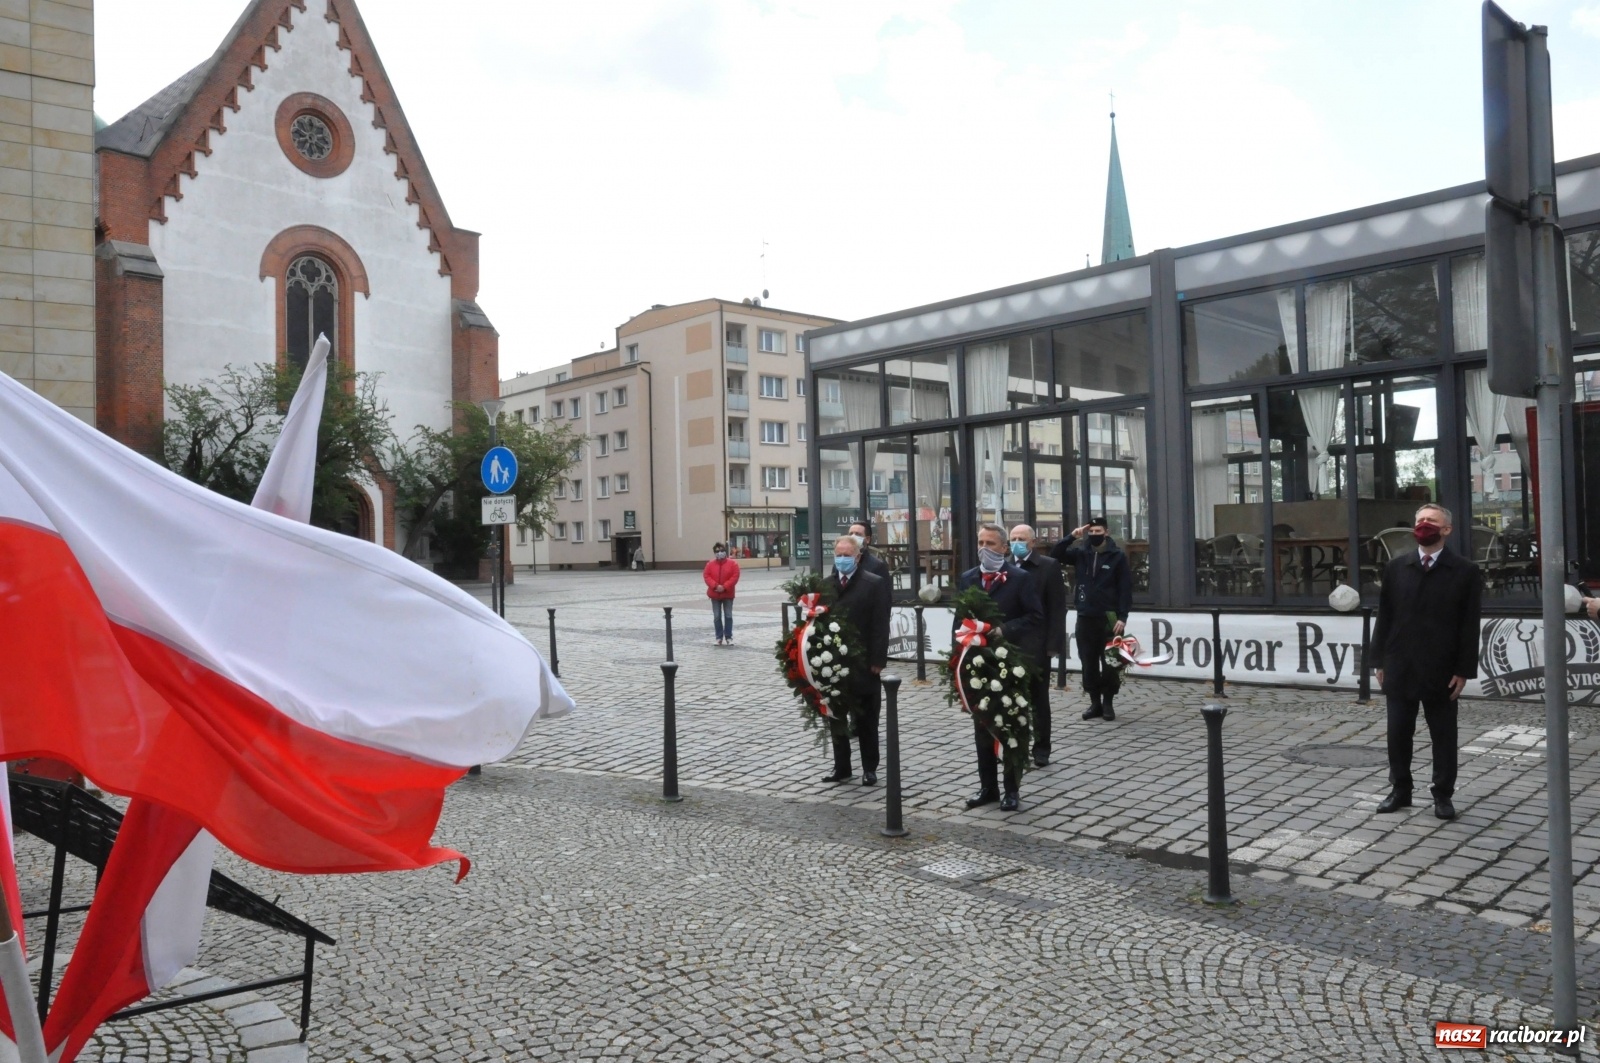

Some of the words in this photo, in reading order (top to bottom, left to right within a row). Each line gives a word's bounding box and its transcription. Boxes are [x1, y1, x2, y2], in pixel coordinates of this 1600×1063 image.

[1150, 618, 1283, 672] Browar
[1296, 622, 1376, 685] Ryn
[1495, 676, 1545, 696] Browa
